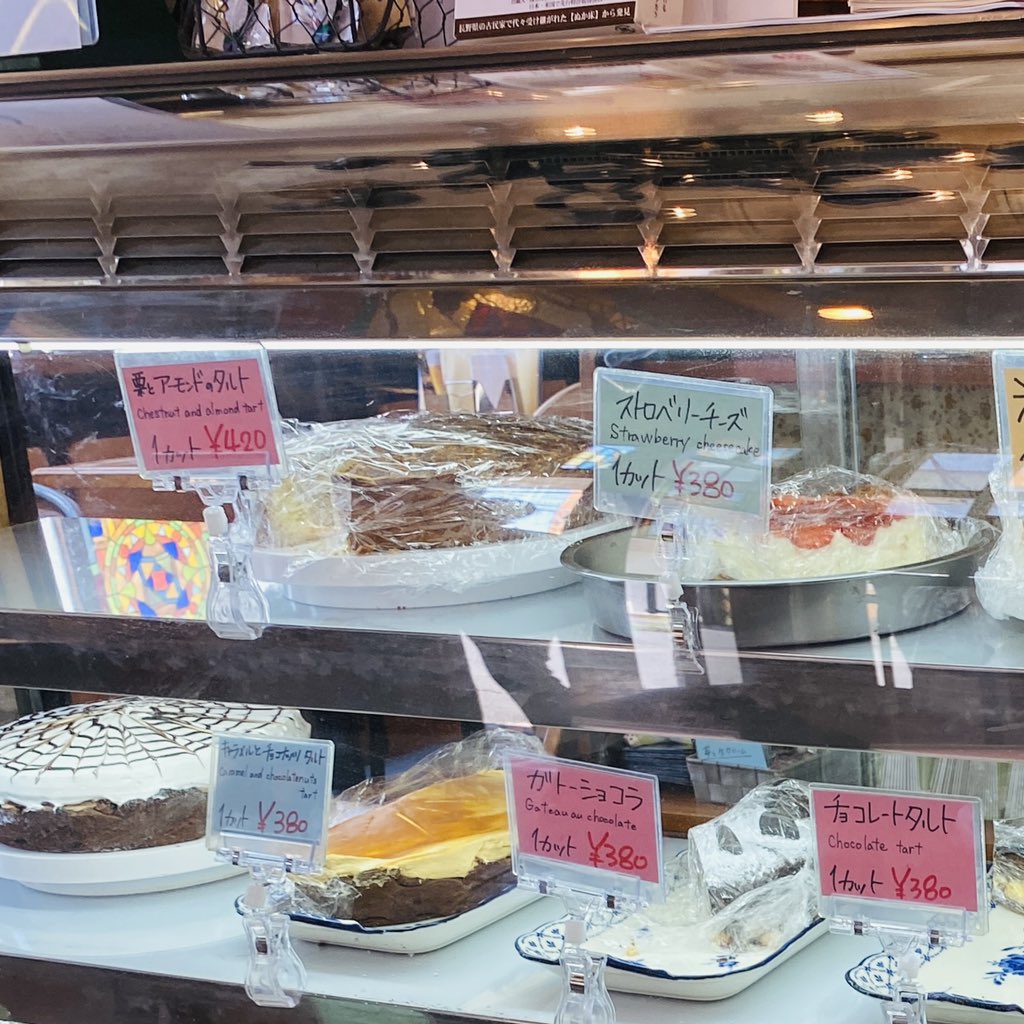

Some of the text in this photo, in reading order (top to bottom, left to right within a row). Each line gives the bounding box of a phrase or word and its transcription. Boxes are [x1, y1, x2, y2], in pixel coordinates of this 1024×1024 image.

[131, 366, 250, 397] 栗とアーモンドのタルト
[185, 404, 202, 417] and
[206, 401, 240, 416] almond
[243, 401, 264, 413] tart
[616, 391, 747, 431] ストロベリーチーズ
[152, 424, 266, 464] 1カット ¥420
[610, 423, 690, 452] Strawberry
[612, 455, 734, 499] 1カット ¥380
[250, 767, 262, 779] and
[527, 770, 643, 811] ガトーショコラ
[219, 801, 308, 834] 1カット ¥380
[525, 798, 637, 831] Gateau au chocolate
[824, 794, 956, 834] チョコレートタルト
[532, 828, 648, 870] 1カット ¥380
[828, 833, 923, 855] Chocolate tart
[829, 865, 952, 901] 1カット ¥380
